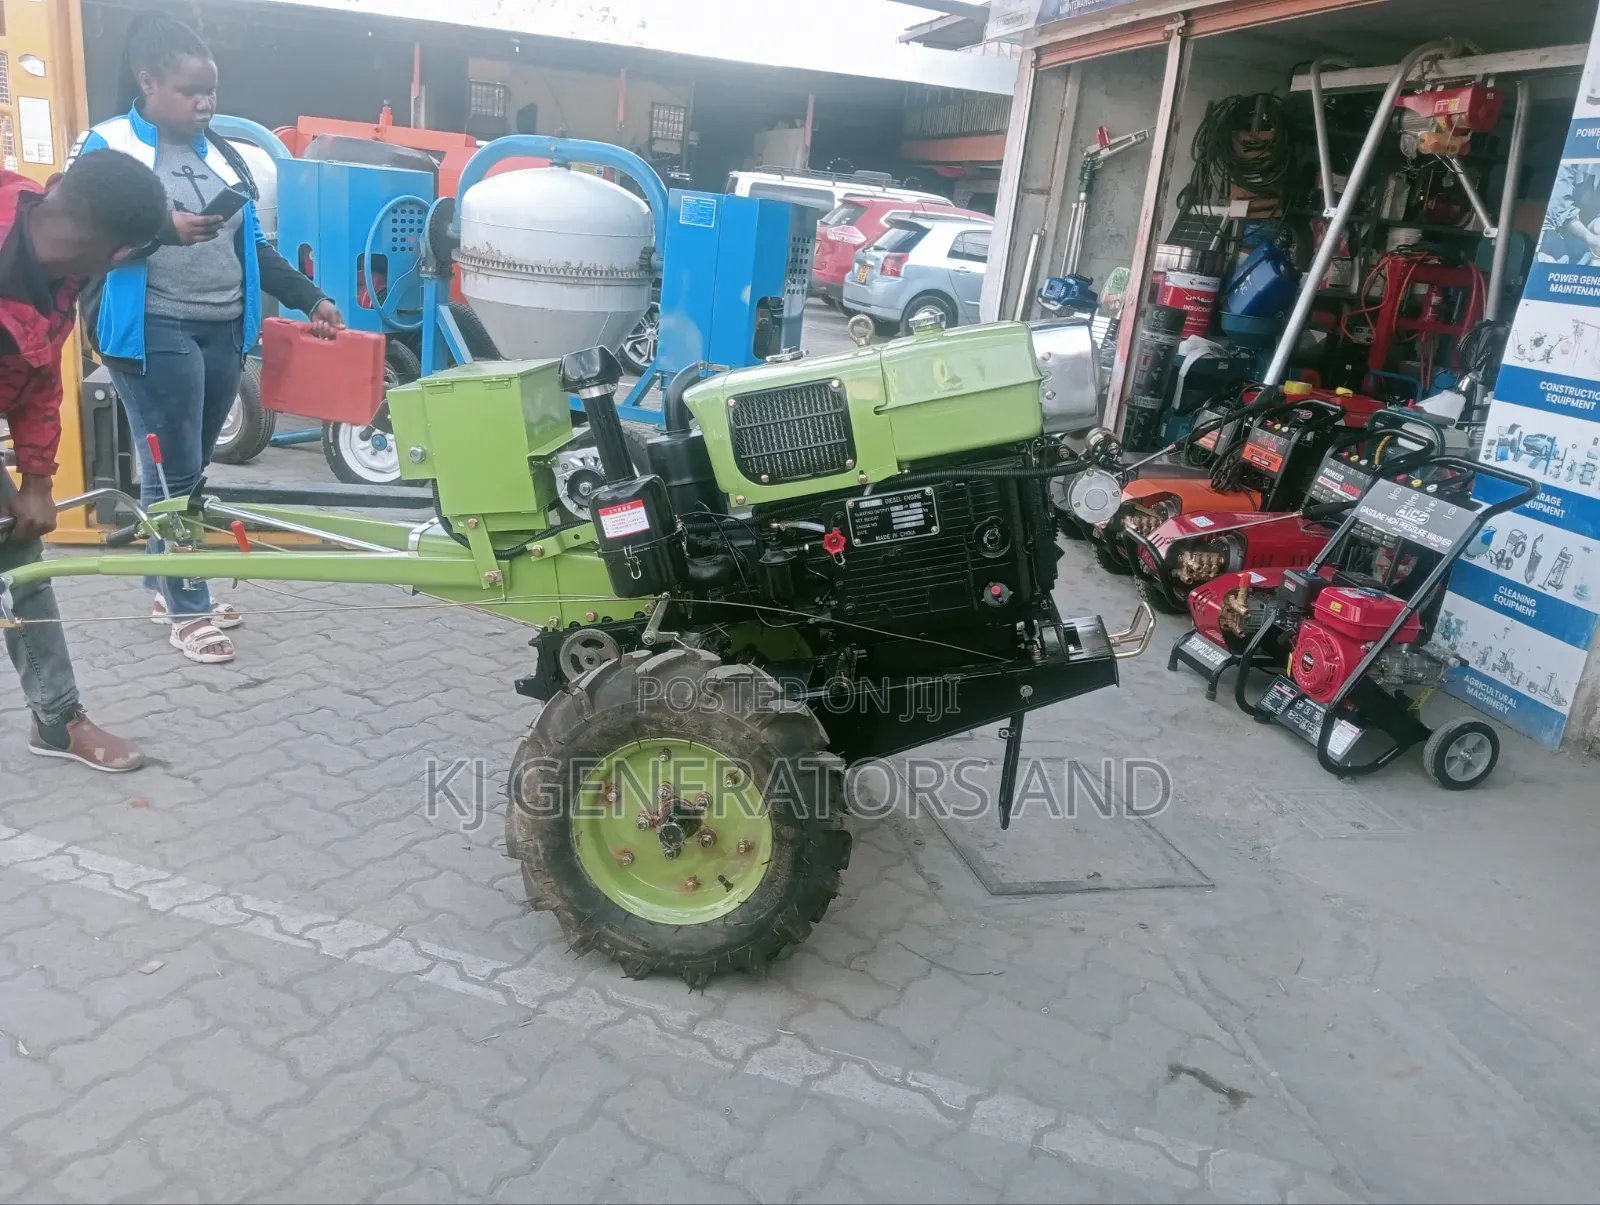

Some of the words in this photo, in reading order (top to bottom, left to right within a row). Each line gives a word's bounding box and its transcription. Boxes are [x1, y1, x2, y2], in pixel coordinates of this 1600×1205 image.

[1548, 272, 1579, 283] POWER
[1546, 393, 1596, 411] EQUIPMENT
[1323, 468, 1345, 482] PIONEER
[885, 497, 902, 505] DIESEL
[904, 493, 922, 502] ENGINE
[1537, 492, 1562, 507] RAGE
[1524, 500, 1566, 519] QUIPMENT
[875, 533, 890, 541] MADE
[900, 530, 916, 538] CHINA
[1360, 506, 1387, 521] GASOLINE
[1384, 514, 1399, 526] HIGH
[1399, 520, 1428, 538] PRESSURE
[1426, 532, 1453, 547] WASHER
[1493, 593, 1537, 618] EQUIPMENT
[1498, 586, 1537, 607] CLEANING
[1463, 674, 1517, 709] AGRICULTURAL
[1466, 686, 1510, 714] MACHINERY
